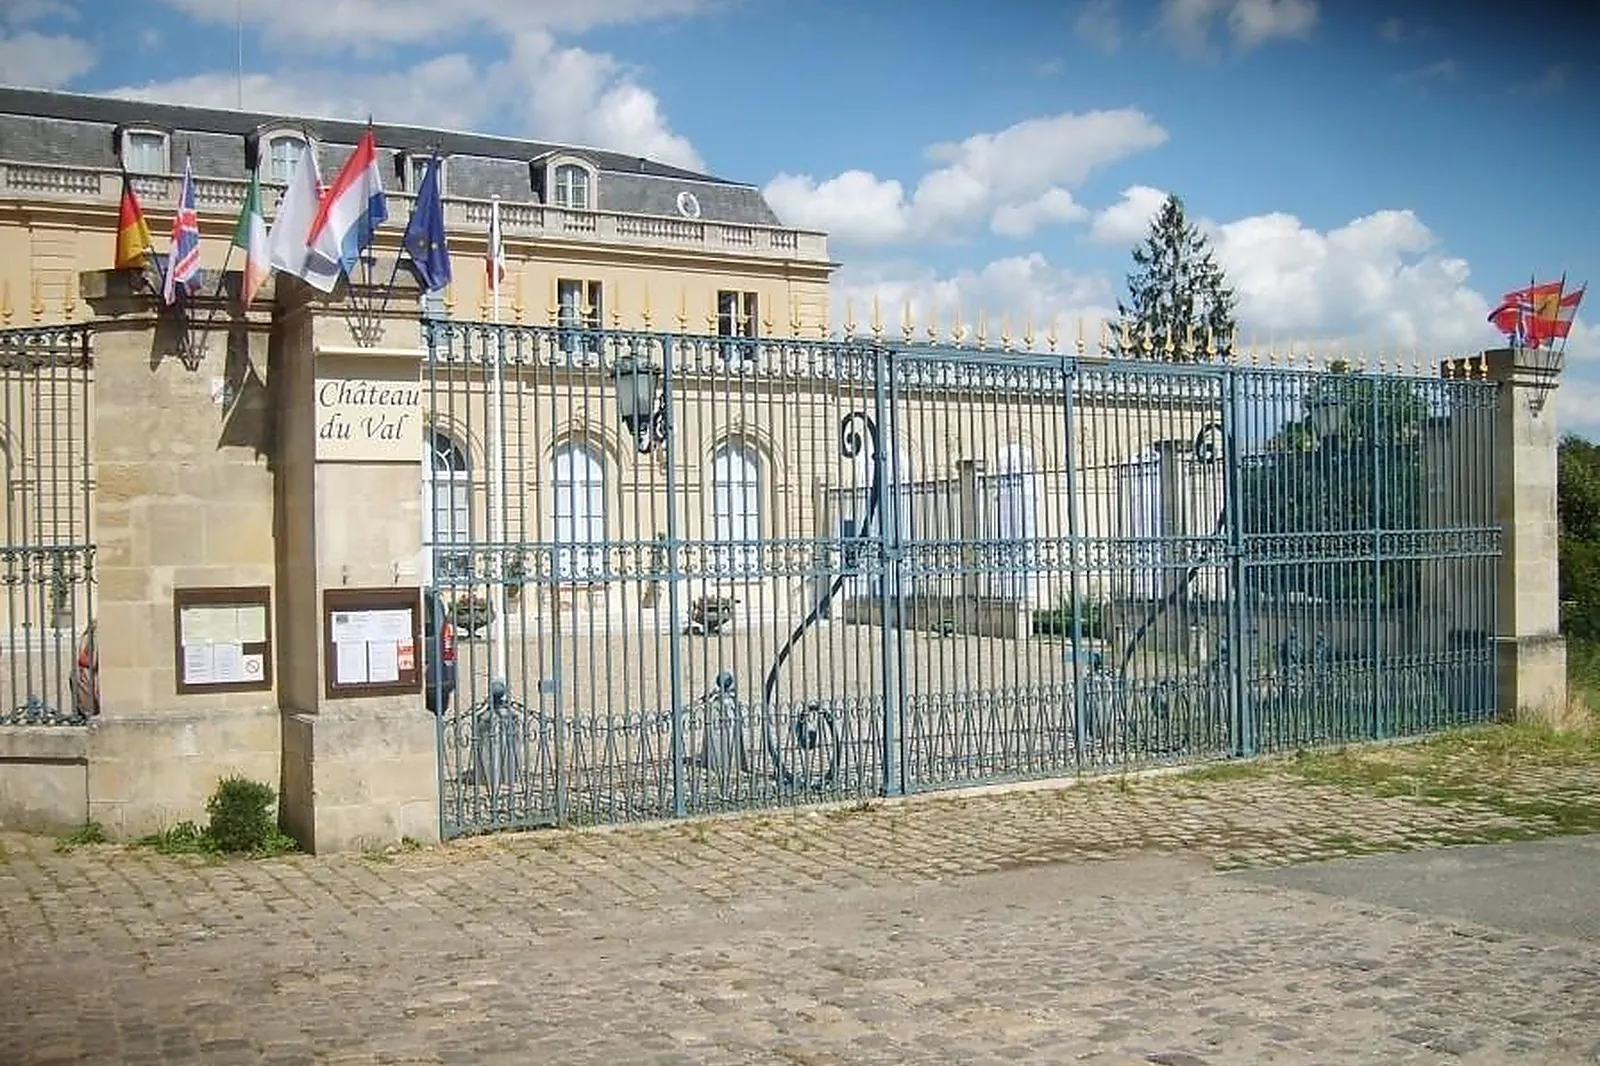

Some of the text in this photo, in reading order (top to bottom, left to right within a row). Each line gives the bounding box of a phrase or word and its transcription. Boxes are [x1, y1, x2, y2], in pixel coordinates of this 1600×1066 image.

[319, 379, 420, 408] Château
[319, 413, 412, 440] du Val
